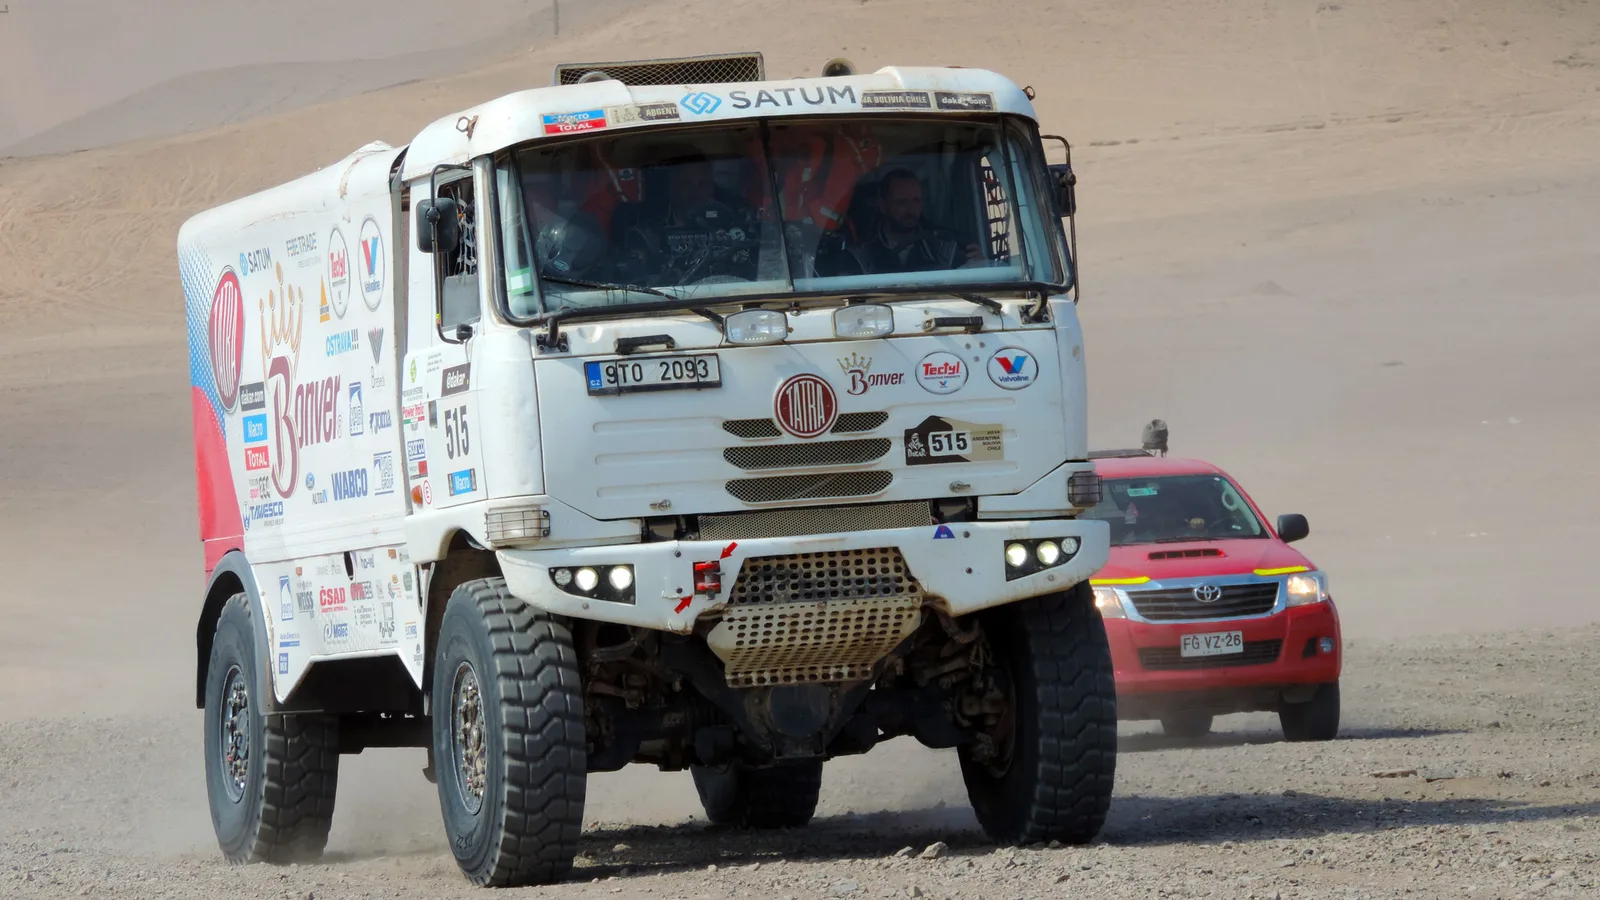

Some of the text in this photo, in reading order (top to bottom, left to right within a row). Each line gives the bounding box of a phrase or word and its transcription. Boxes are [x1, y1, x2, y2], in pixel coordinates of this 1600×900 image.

[732, 85, 857, 109] SATUM
[874, 95, 905, 104] BOLIVIA
[906, 96, 928, 104] CHILE
[248, 248, 272, 273] SATUM
[660, 359, 709, 381] 2093
[922, 361, 961, 376] Tectyl
[998, 375, 1029, 383] Valvoline
[847, 369, 904, 395] Bonver
[785, 380, 826, 432] TATRA
[268, 356, 341, 499] Bonver
[444, 405, 469, 460] 515
[931, 432, 968, 452] 515
[247, 450, 268, 468] TOTAL
[331, 467, 368, 501] WABCO
[319, 585, 346, 606] ČSAD
